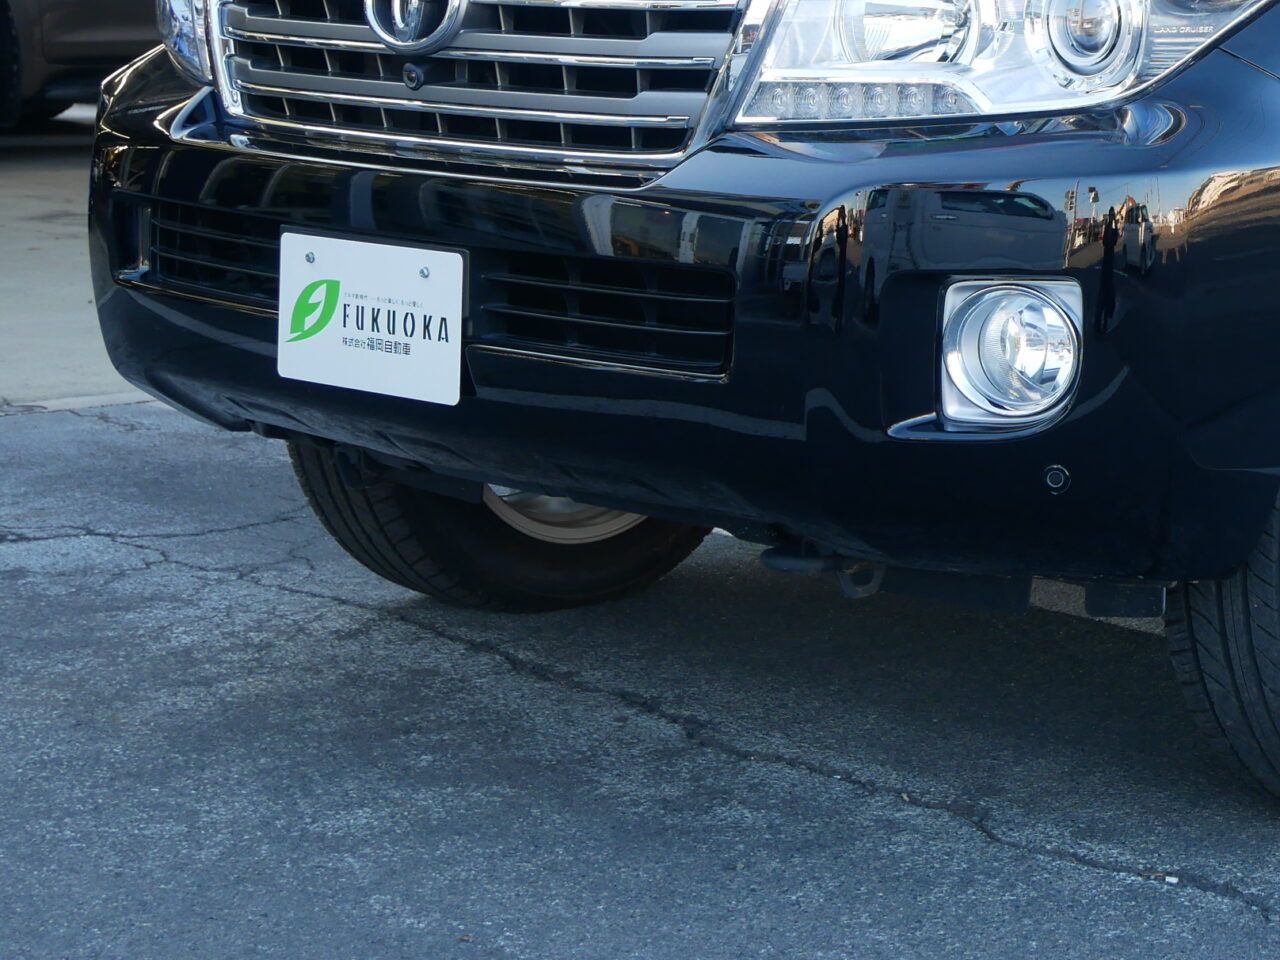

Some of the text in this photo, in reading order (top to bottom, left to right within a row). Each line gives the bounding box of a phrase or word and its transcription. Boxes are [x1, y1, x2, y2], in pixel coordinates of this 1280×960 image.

[1152, 24, 1214, 34] LAND CRUISER
[342, 303, 450, 343] FUKUOKA
[341, 336, 411, 356] 株式会社福岡自動車
